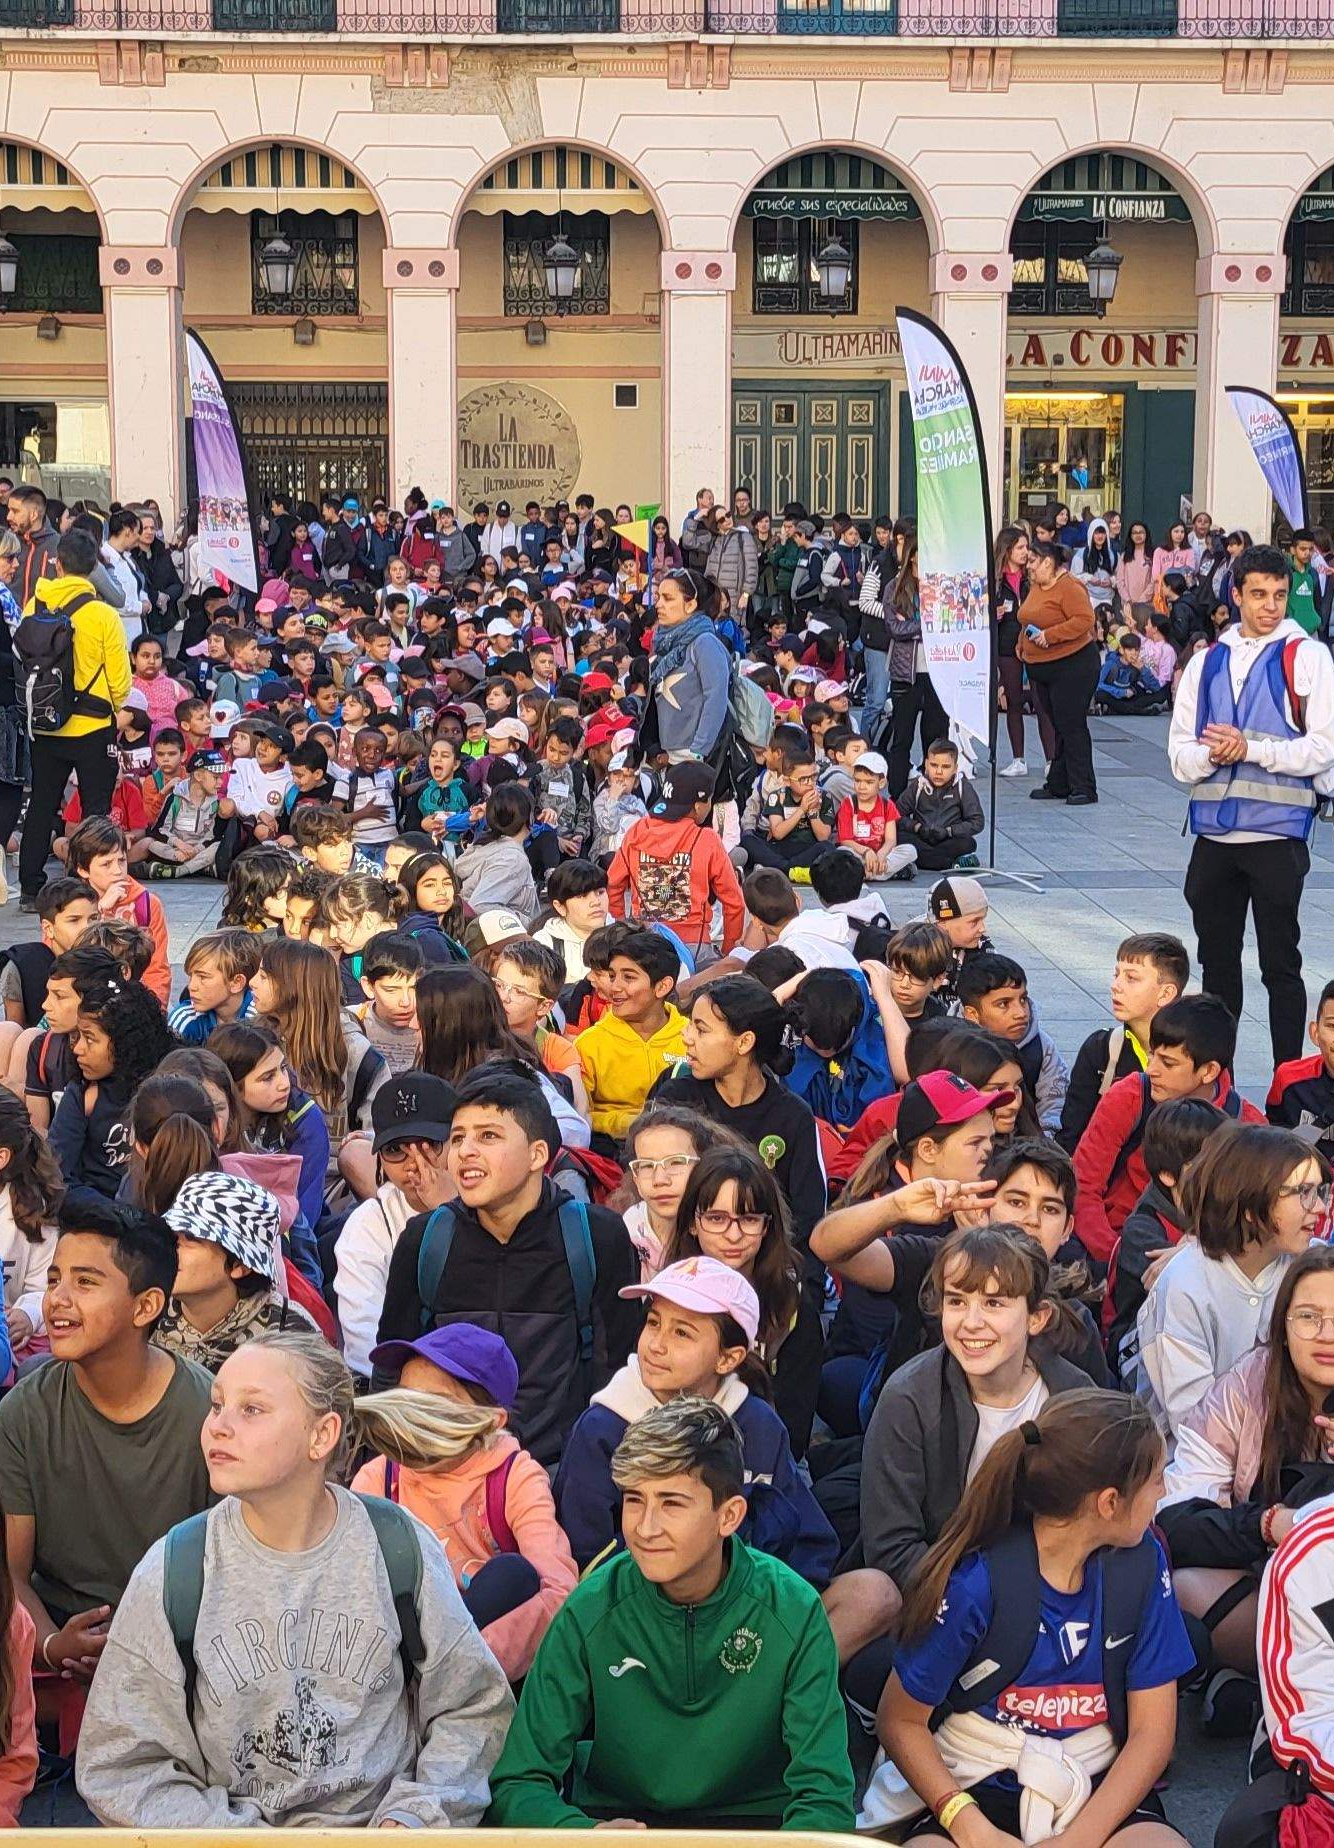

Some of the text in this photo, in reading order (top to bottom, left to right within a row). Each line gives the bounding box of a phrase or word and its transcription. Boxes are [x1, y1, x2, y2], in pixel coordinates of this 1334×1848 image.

[753, 195, 908, 216] pruebe sus especialidades
[1092, 197, 1105, 218] LA
[1108, 197, 1165, 218] CONFIANZA
[499, 413, 518, 442] LA
[460, 439, 556, 470] TRASTIENDA
